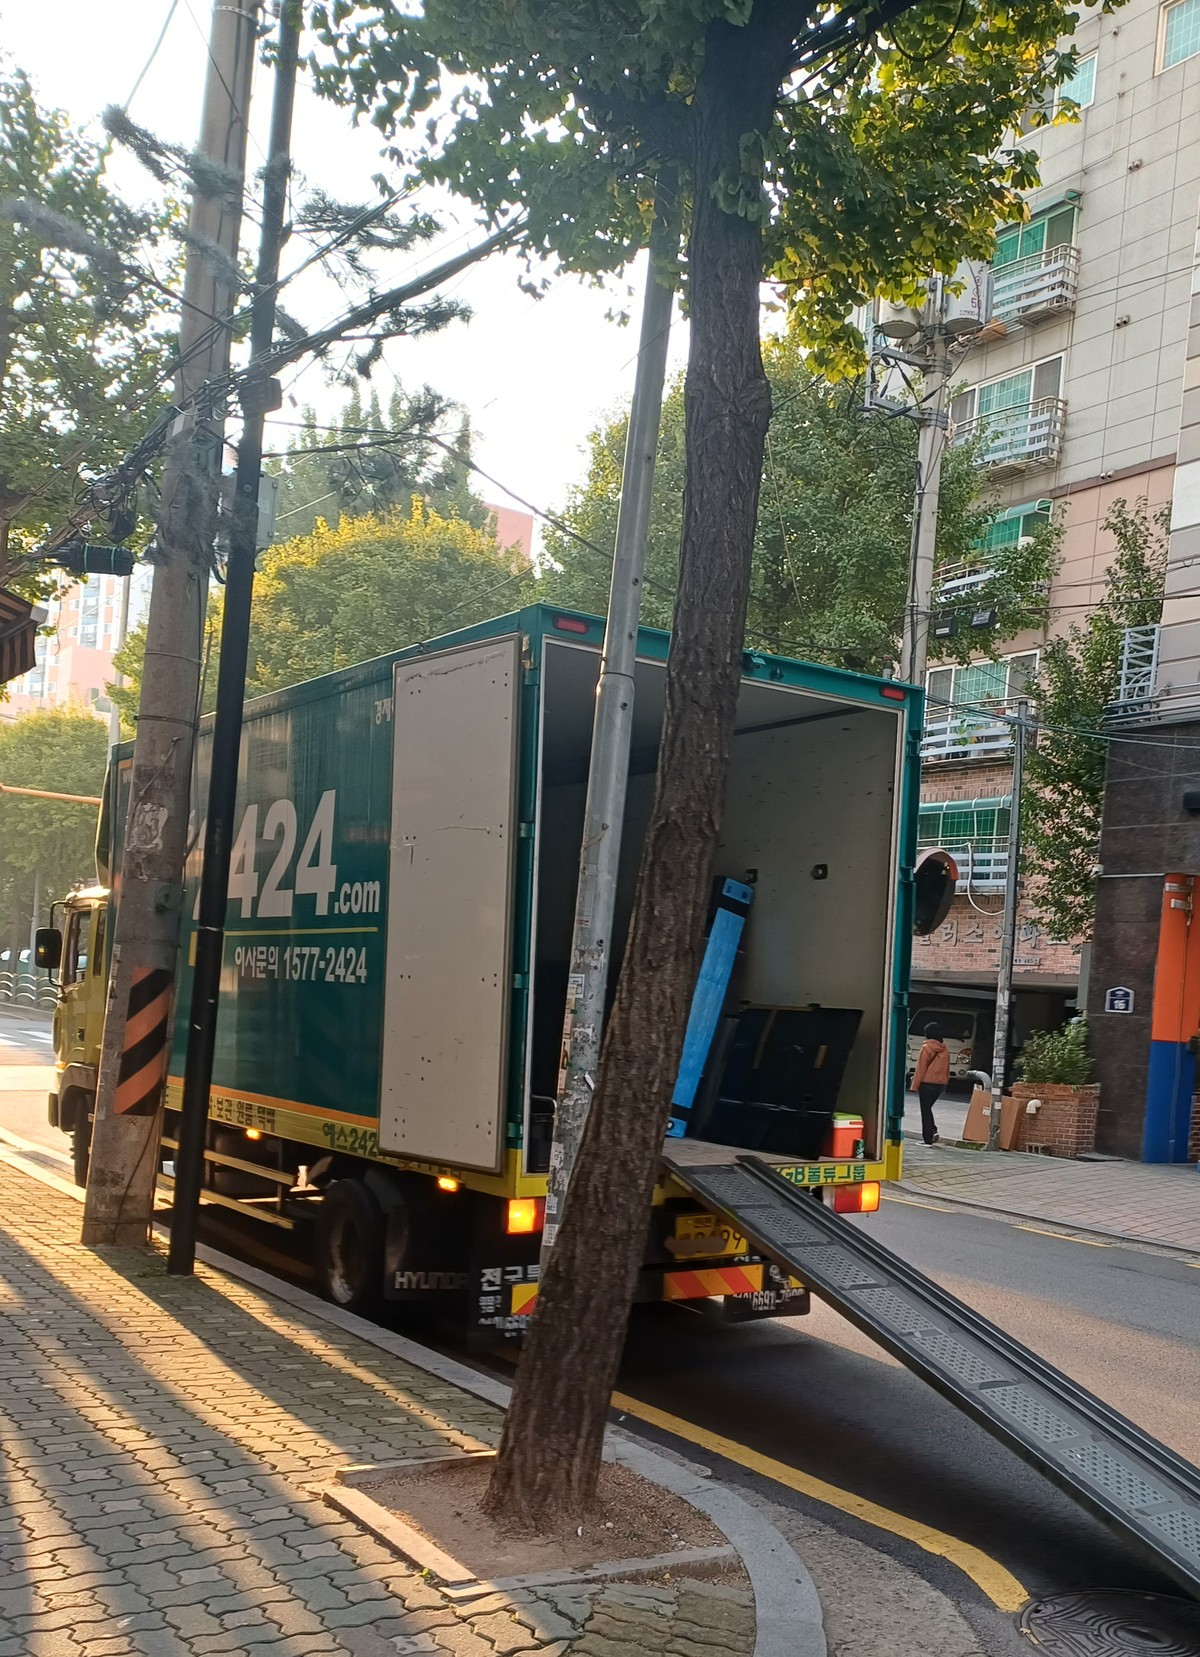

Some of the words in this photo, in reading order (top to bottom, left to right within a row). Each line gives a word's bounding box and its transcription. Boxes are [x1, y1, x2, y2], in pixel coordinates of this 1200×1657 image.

[234, 946, 279, 979] 이사문의
[283, 946, 367, 984] 1577-2424
[322, 1122, 379, 1157] 예스242
